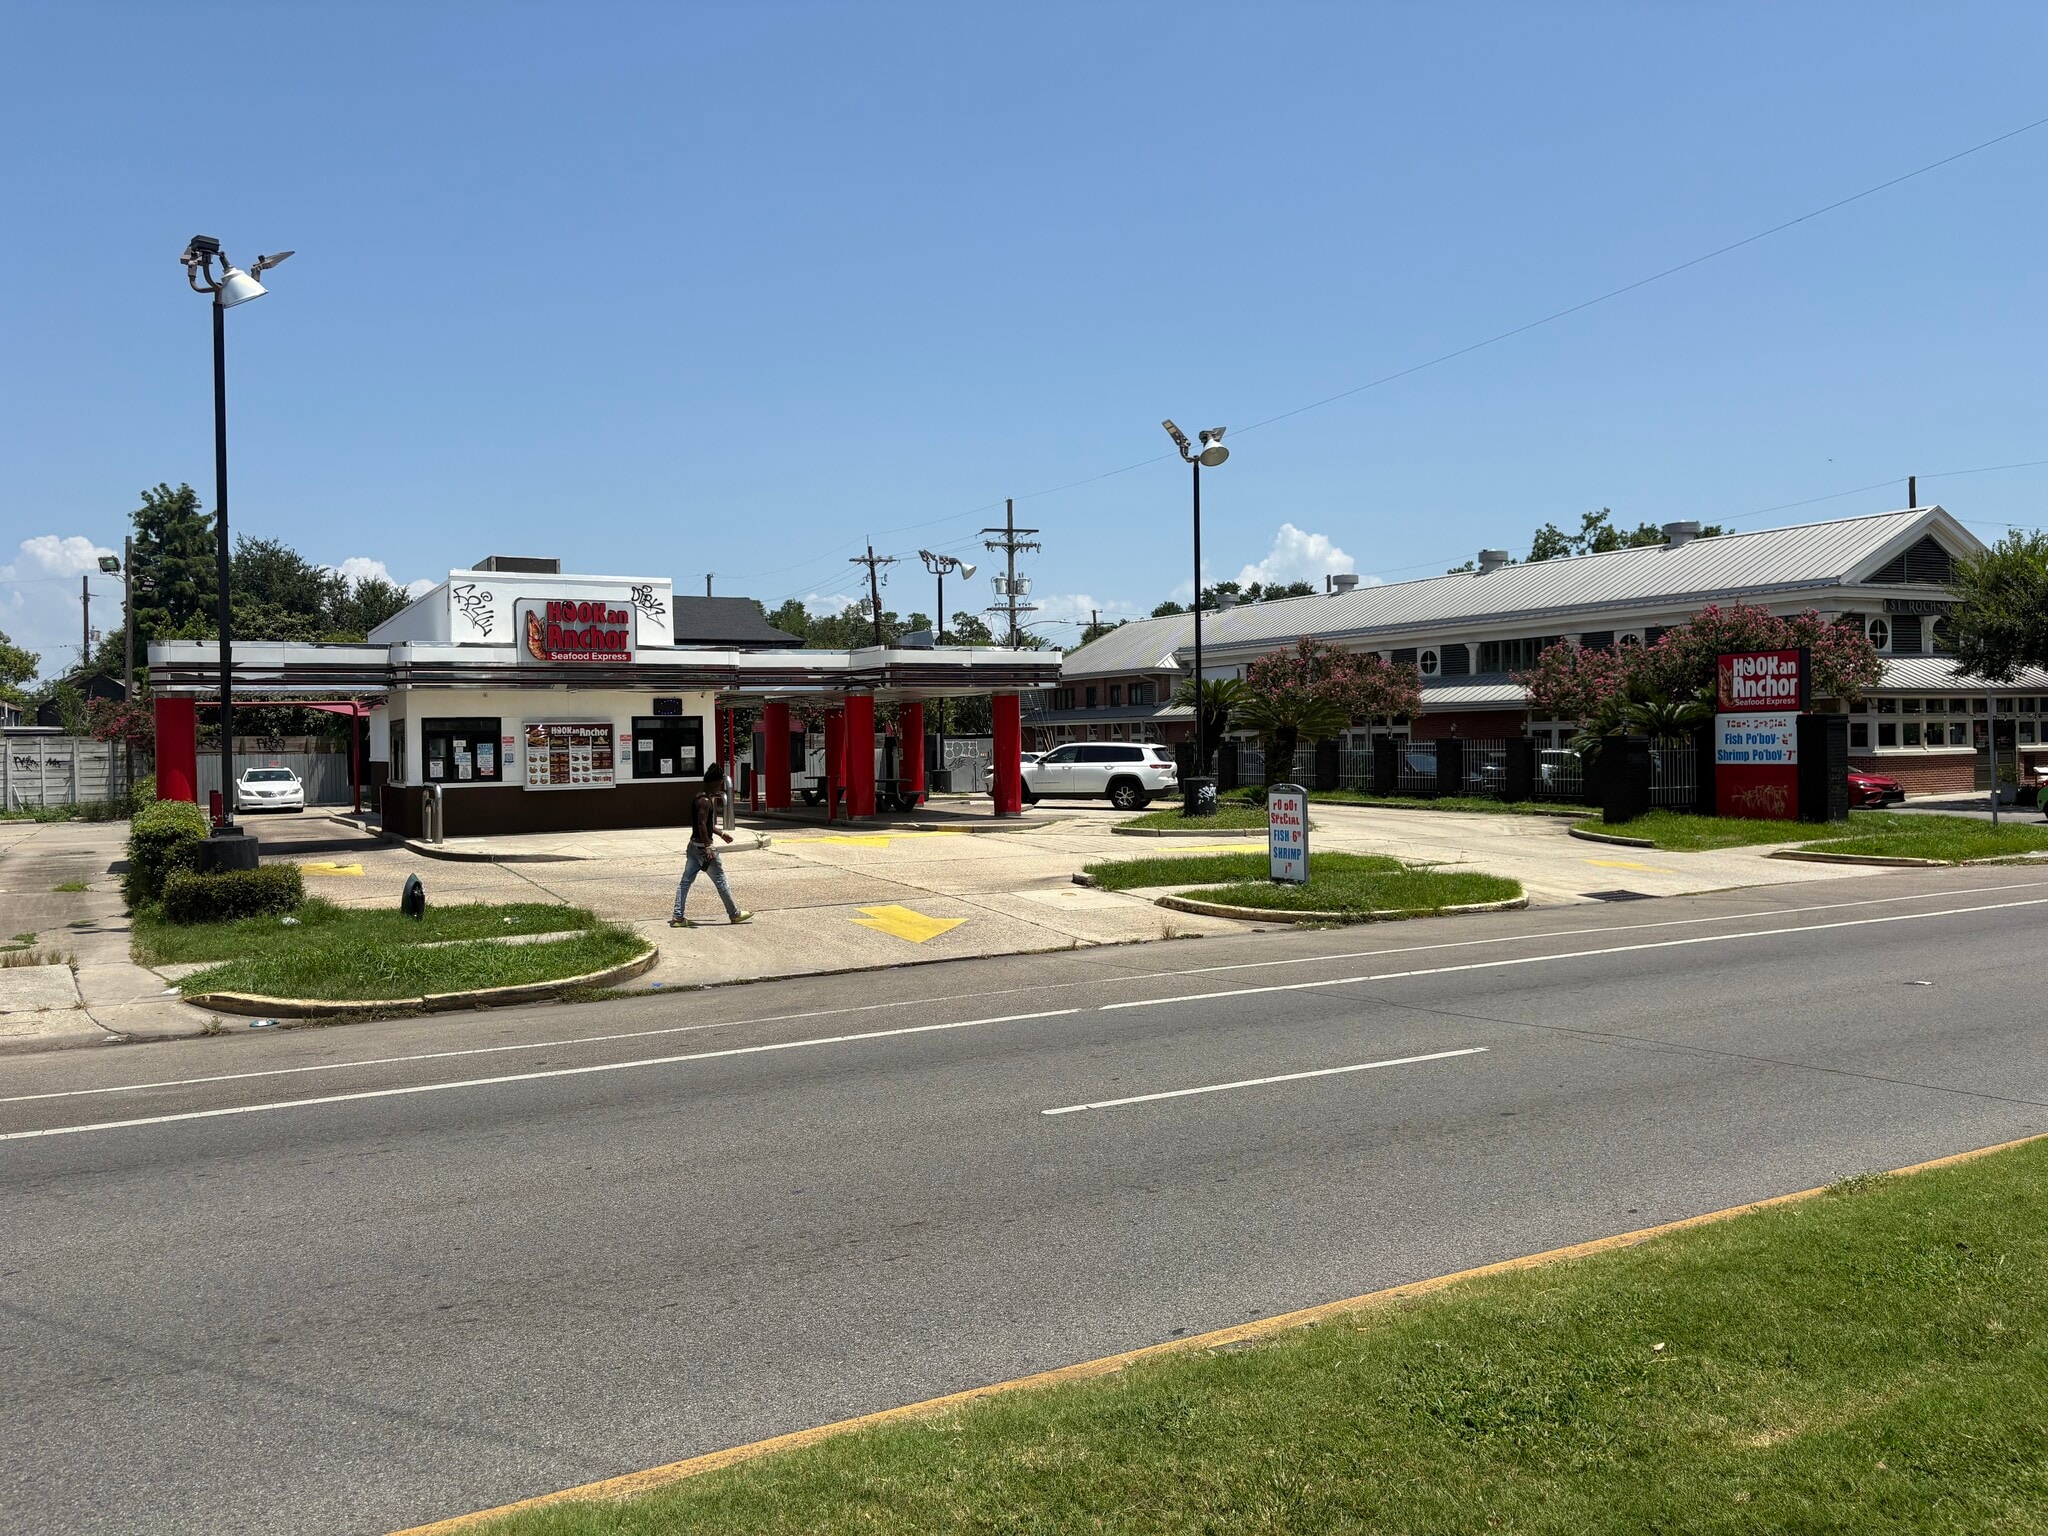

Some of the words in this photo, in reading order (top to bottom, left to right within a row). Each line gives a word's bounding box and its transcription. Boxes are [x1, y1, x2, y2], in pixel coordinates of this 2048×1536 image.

[547, 601, 607, 623] HOOK
[607, 610, 629, 624] an
[1908, 600, 1937, 614] ROCH
[547, 625, 629, 650] Anchor
[551, 652, 589, 661] Seafood
[592, 652, 627, 662] Express
[1732, 656, 1779, 677] HOOK
[1779, 661, 1797, 675] an
[1732, 674, 1798, 698] Anchor
[1735, 698, 1765, 706] Seafood
[1766, 698, 1796, 706] Express
[580, 728, 609, 737] Anchor
[1725, 733, 1743, 745] Fish
[1717, 749, 1749, 762] Shrimp
[1271, 812, 1300, 825] SPECIAL
[1273, 829, 1290, 842] FISH
[1273, 846, 1302, 860] SHRIMP
